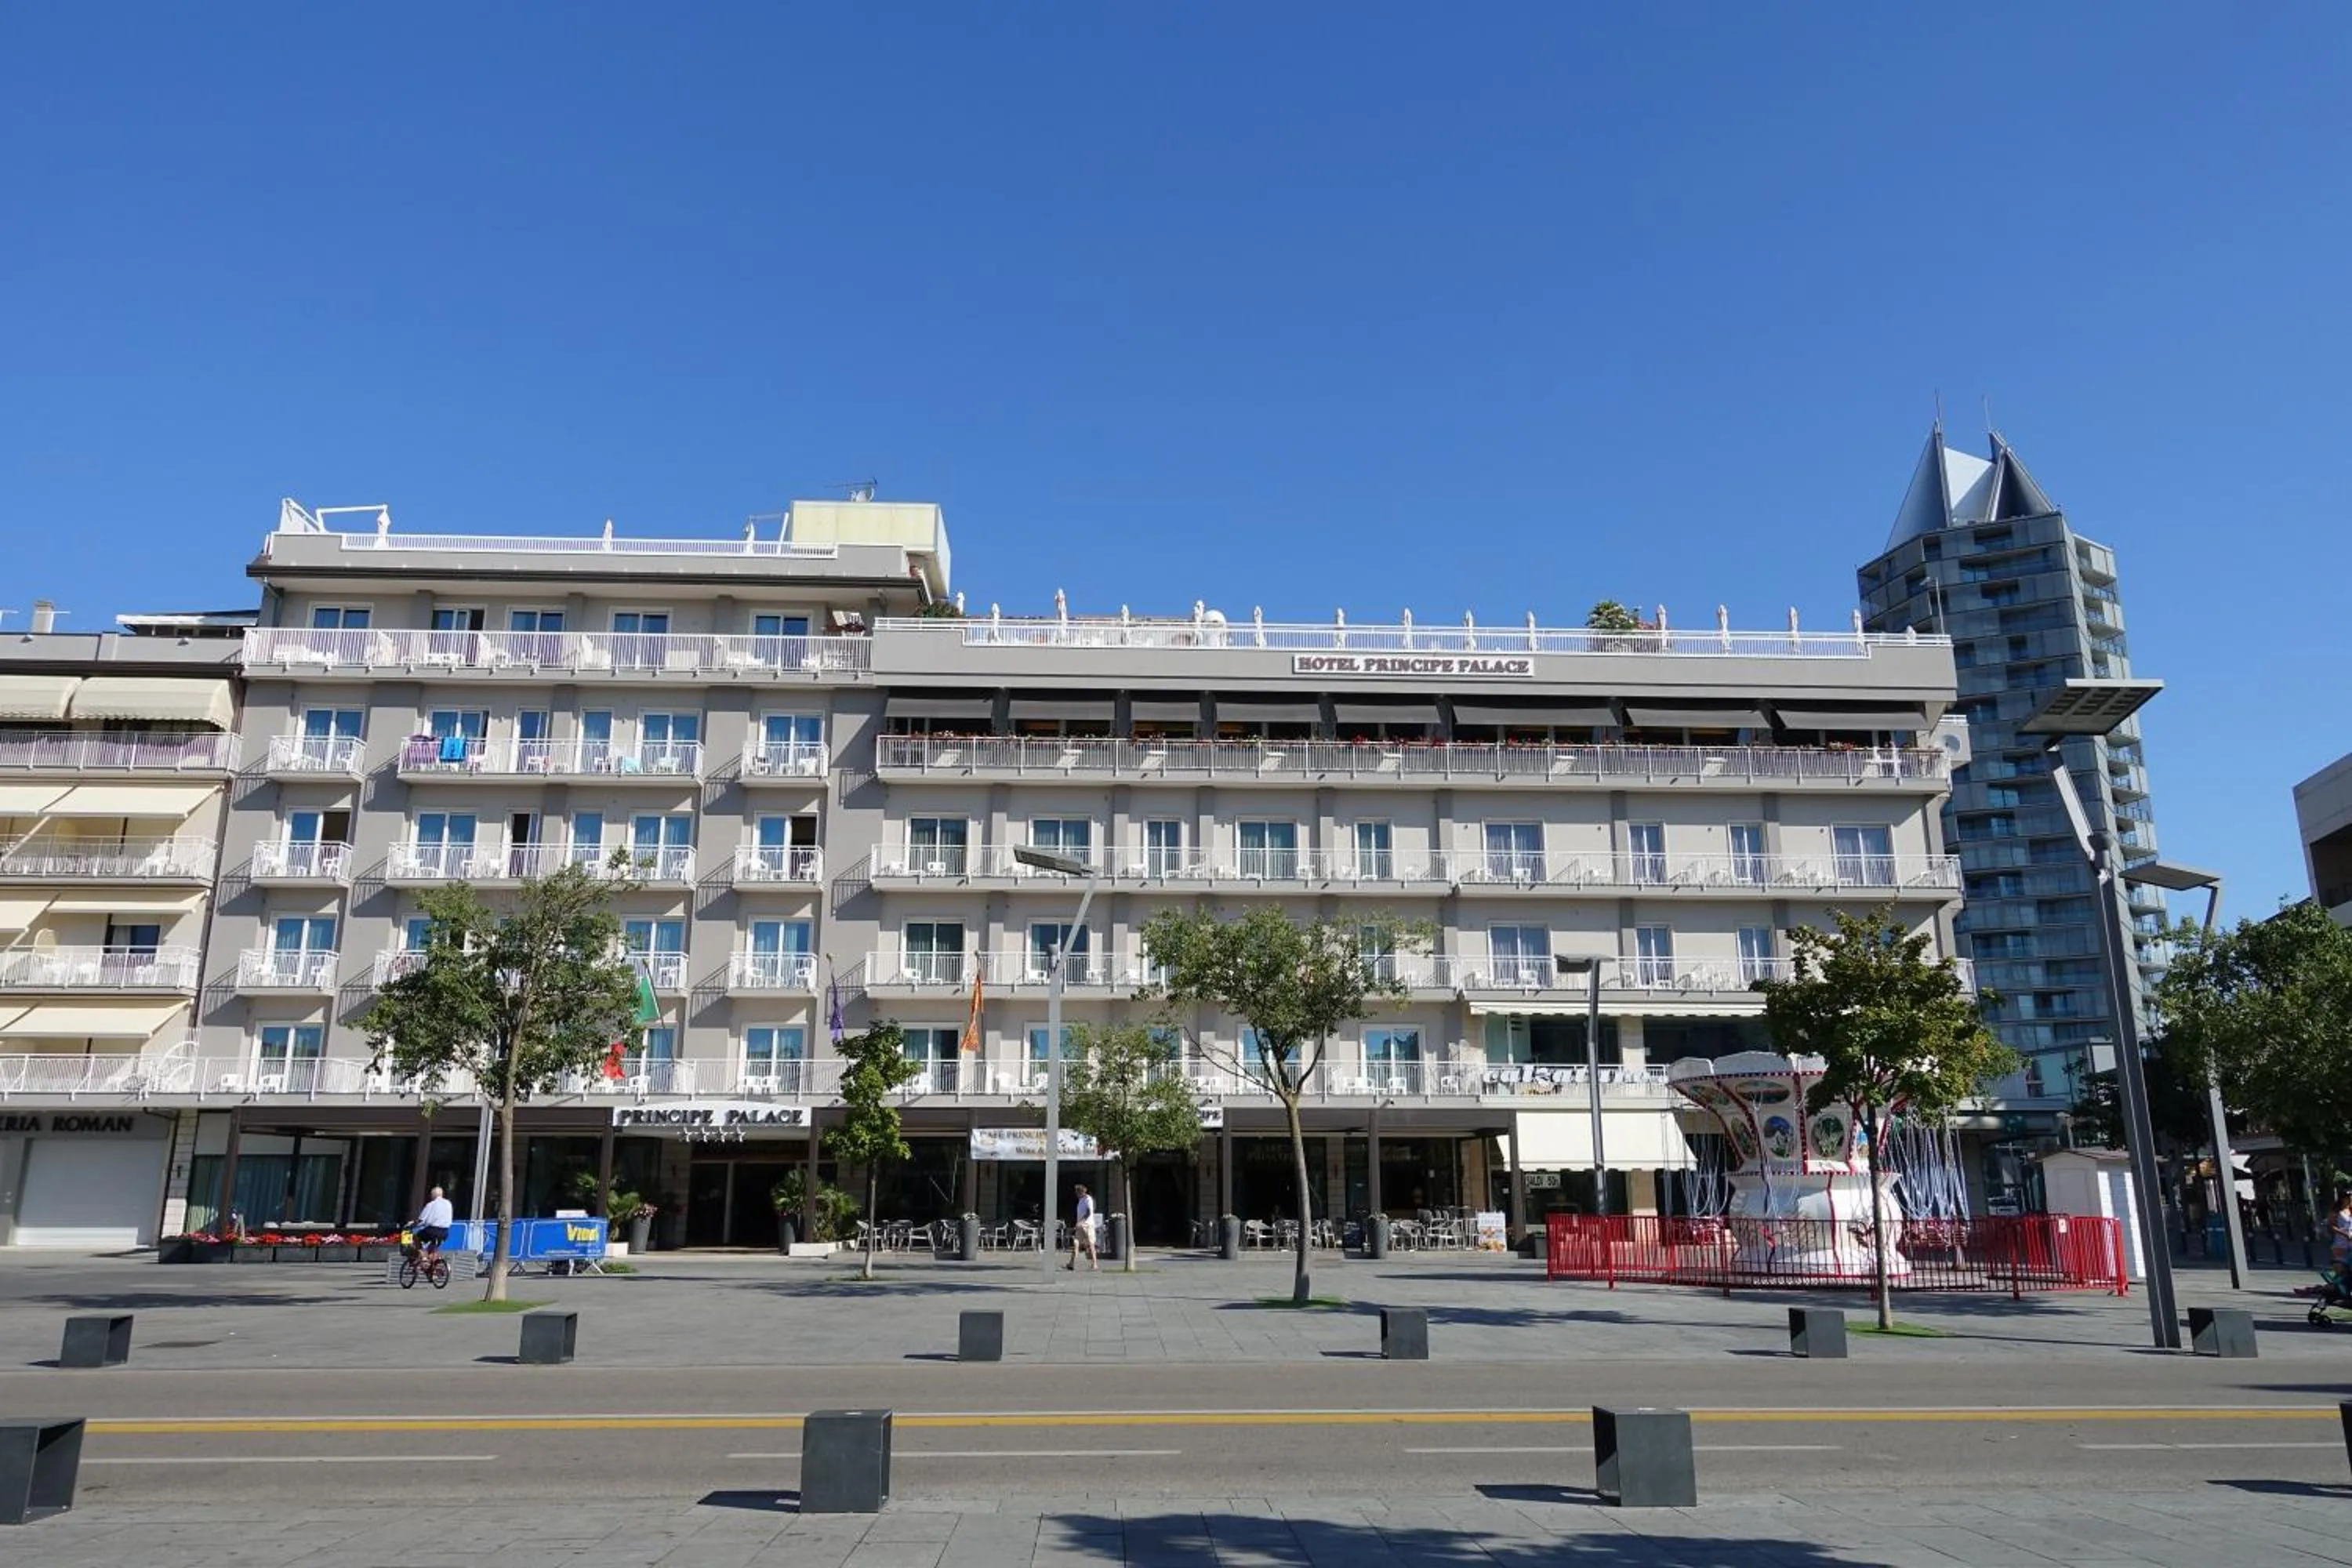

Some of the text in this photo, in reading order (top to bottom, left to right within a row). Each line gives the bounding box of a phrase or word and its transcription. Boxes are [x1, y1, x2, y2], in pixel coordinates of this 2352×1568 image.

[1298, 656, 1530, 673] HOTEL PRINCIPE PALACE
[52, 1116, 134, 1131] ROMAN
[618, 1109, 803, 1124] PRINCIPE PALACE
[1007, 1131, 1049, 1140] PRINCIP
